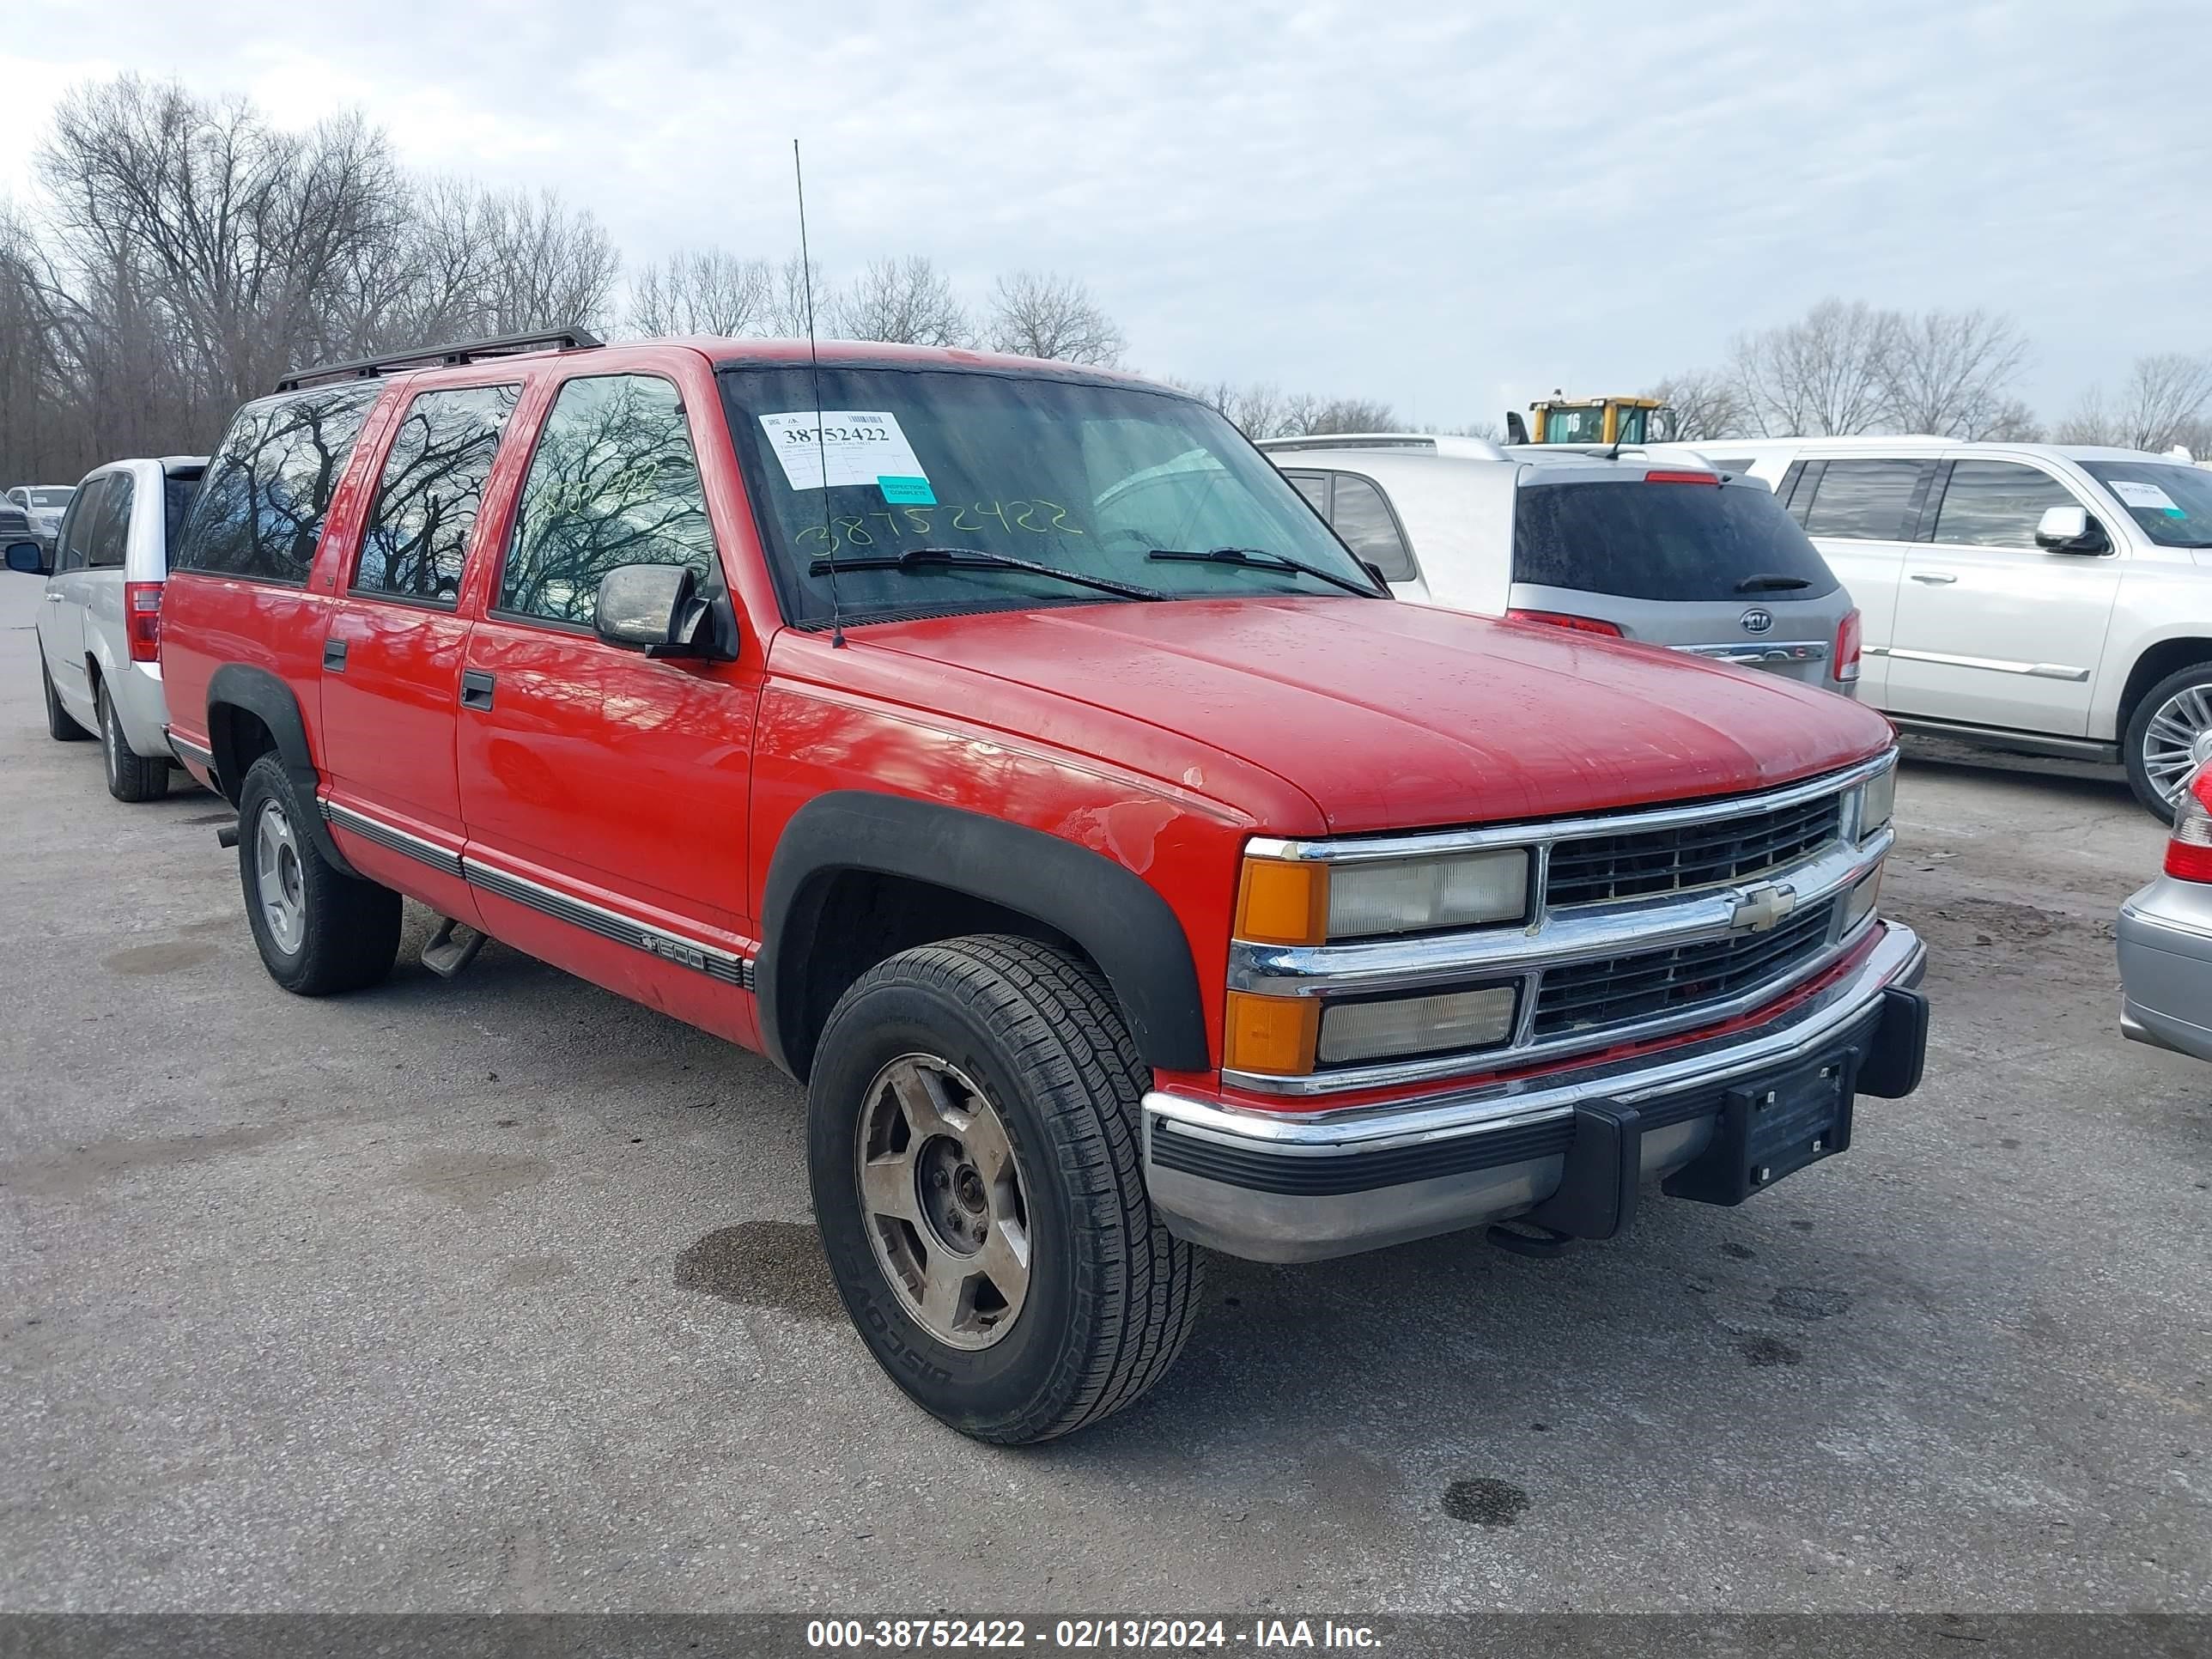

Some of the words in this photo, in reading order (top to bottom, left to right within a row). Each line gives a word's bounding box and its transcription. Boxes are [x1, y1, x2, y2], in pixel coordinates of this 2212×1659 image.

[1566, 412, 1580, 432] 16
[782, 427, 890, 443] 38752422
[795, 500, 1084, 556] 38752422
